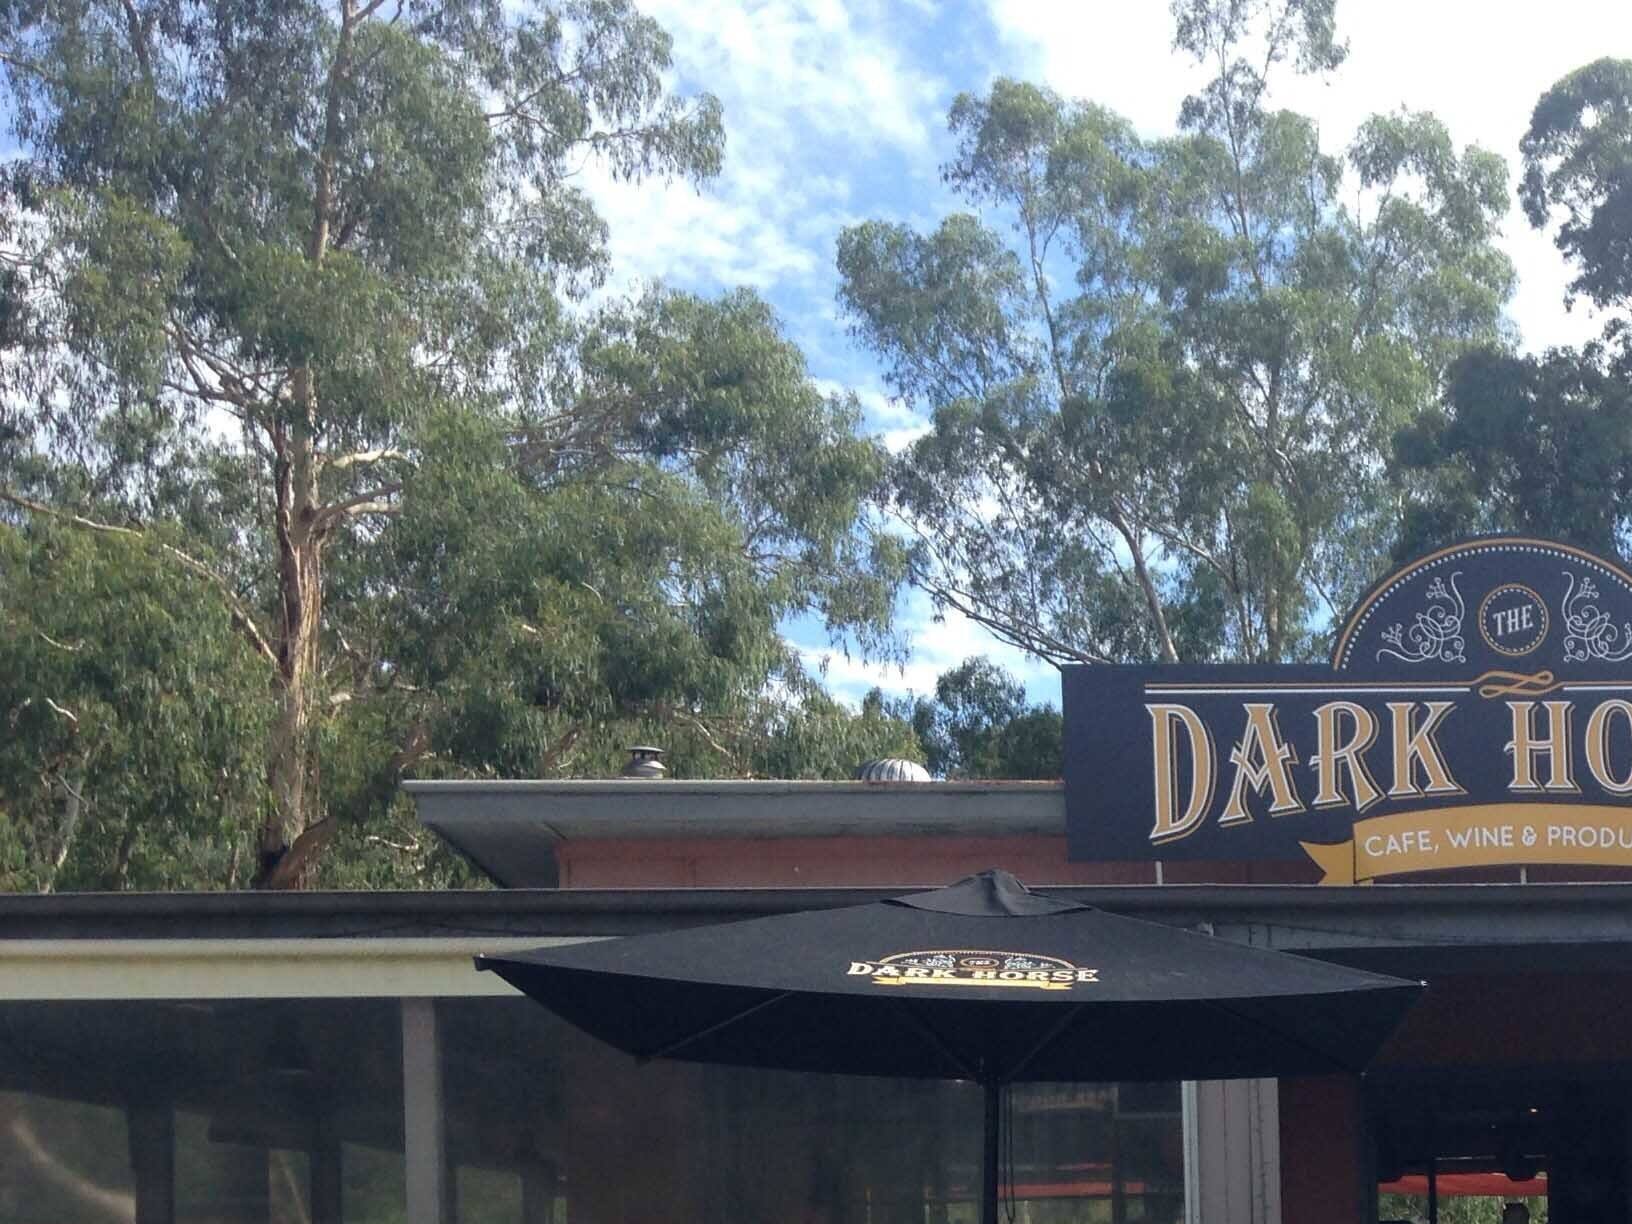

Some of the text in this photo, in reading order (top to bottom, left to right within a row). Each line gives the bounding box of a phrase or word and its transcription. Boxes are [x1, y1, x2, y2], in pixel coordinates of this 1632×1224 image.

[1492, 604, 1534, 636] THE
[1145, 701, 1467, 845] DARK
[1364, 830, 1439, 857] CAFE,
[1445, 825, 1514, 849] WINE
[1521, 825, 1537, 847] &
[847, 961, 1099, 982] DARK HORSE
